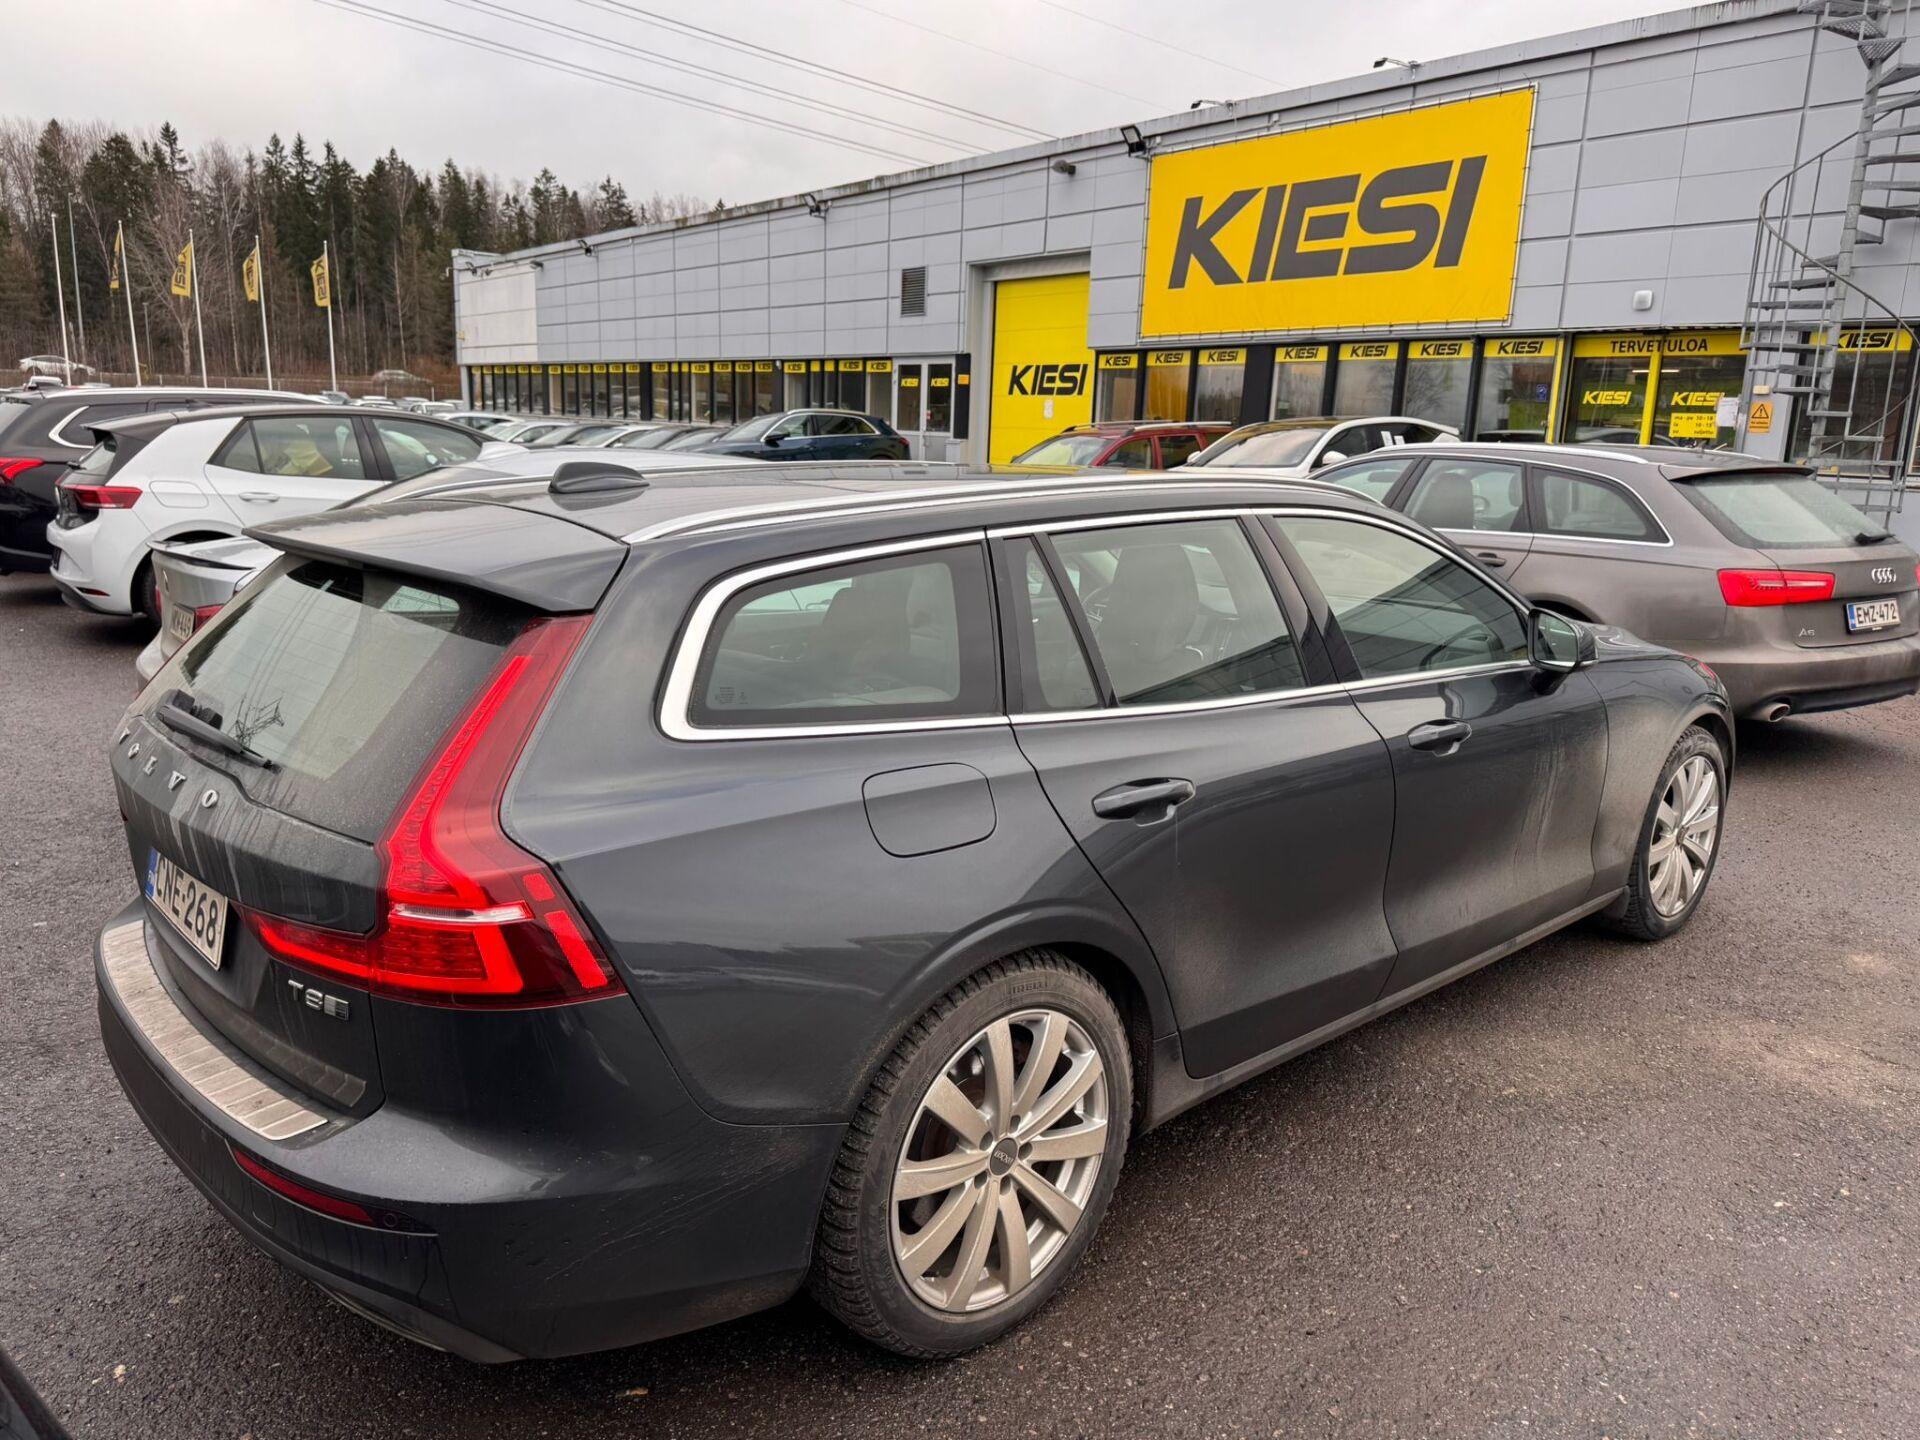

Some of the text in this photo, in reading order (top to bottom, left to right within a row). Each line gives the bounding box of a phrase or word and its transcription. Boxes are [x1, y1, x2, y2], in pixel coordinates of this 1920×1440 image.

[1168, 155, 1487, 289] KIESI
[1350, 344, 1389, 358] KIESI
[1420, 342, 1462, 356] KIESI
[1498, 340, 1543, 355] KIESI
[1611, 338, 1708, 353] TERVETULOA
[1105, 355, 1131, 366] KIESI
[1155, 352, 1185, 364] KIESI
[1207, 350, 1238, 362] KIESI
[1284, 347, 1319, 360] KIESI
[1008, 363, 1088, 395] KIESI
[1583, 391, 1632, 405] KIESI
[1856, 603, 1897, 624] EMZ-472
[1799, 628, 1815, 637] A6
[119, 727, 218, 808] VOLVO
[155, 855, 218, 949] CNE-268
[288, 979, 324, 1010] T8
